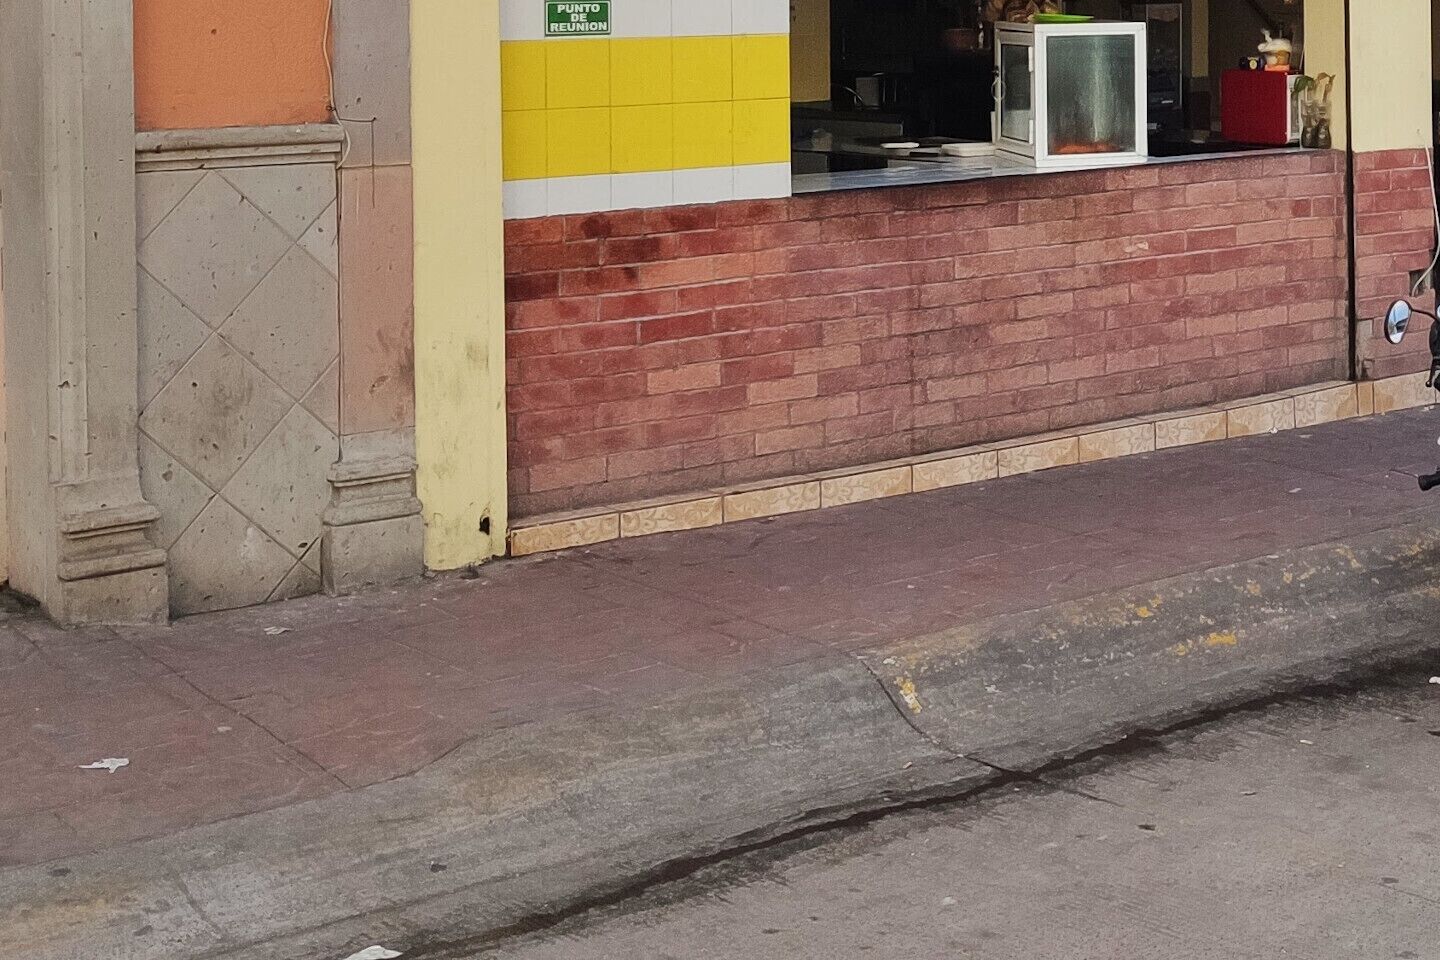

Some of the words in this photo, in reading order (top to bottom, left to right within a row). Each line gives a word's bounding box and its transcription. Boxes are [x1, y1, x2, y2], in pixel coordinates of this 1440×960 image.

[557, 3, 600, 14] PUNTO
[570, 13, 588, 22] DE
[549, 21, 607, 32] REUNION
